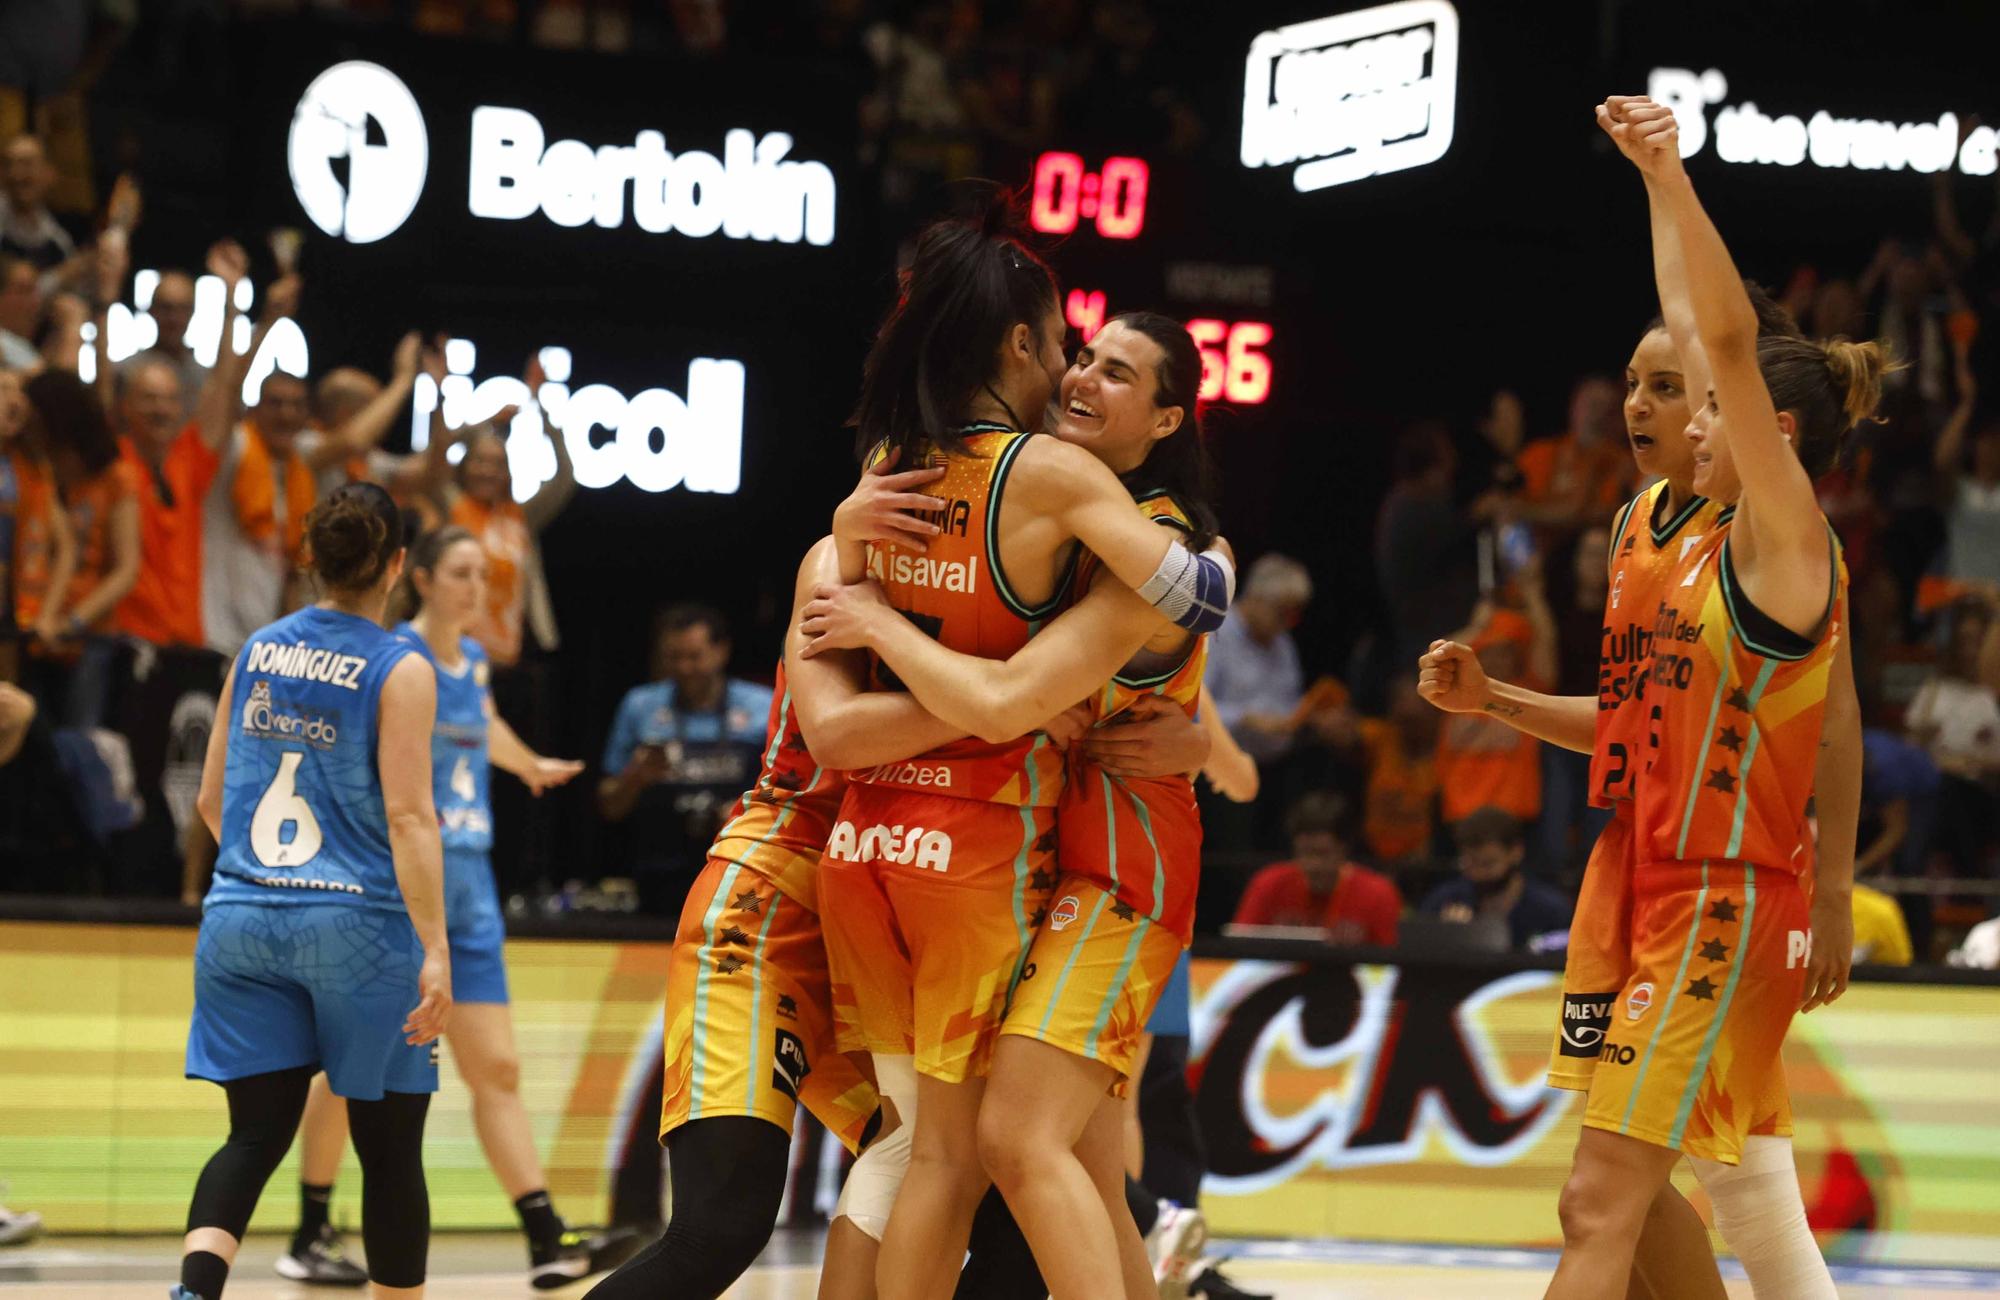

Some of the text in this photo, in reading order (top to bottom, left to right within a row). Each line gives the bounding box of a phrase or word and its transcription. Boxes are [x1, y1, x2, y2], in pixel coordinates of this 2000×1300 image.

[469, 105, 836, 246] Bertolín
[1714, 101, 1808, 166] the
[1808, 110, 1959, 173] travel
[1031, 151, 1150, 240] 0:0
[247, 640, 367, 690] DOMÍNGUEZ
[250, 752, 323, 868] 6
[827, 820, 952, 872] AMESA
